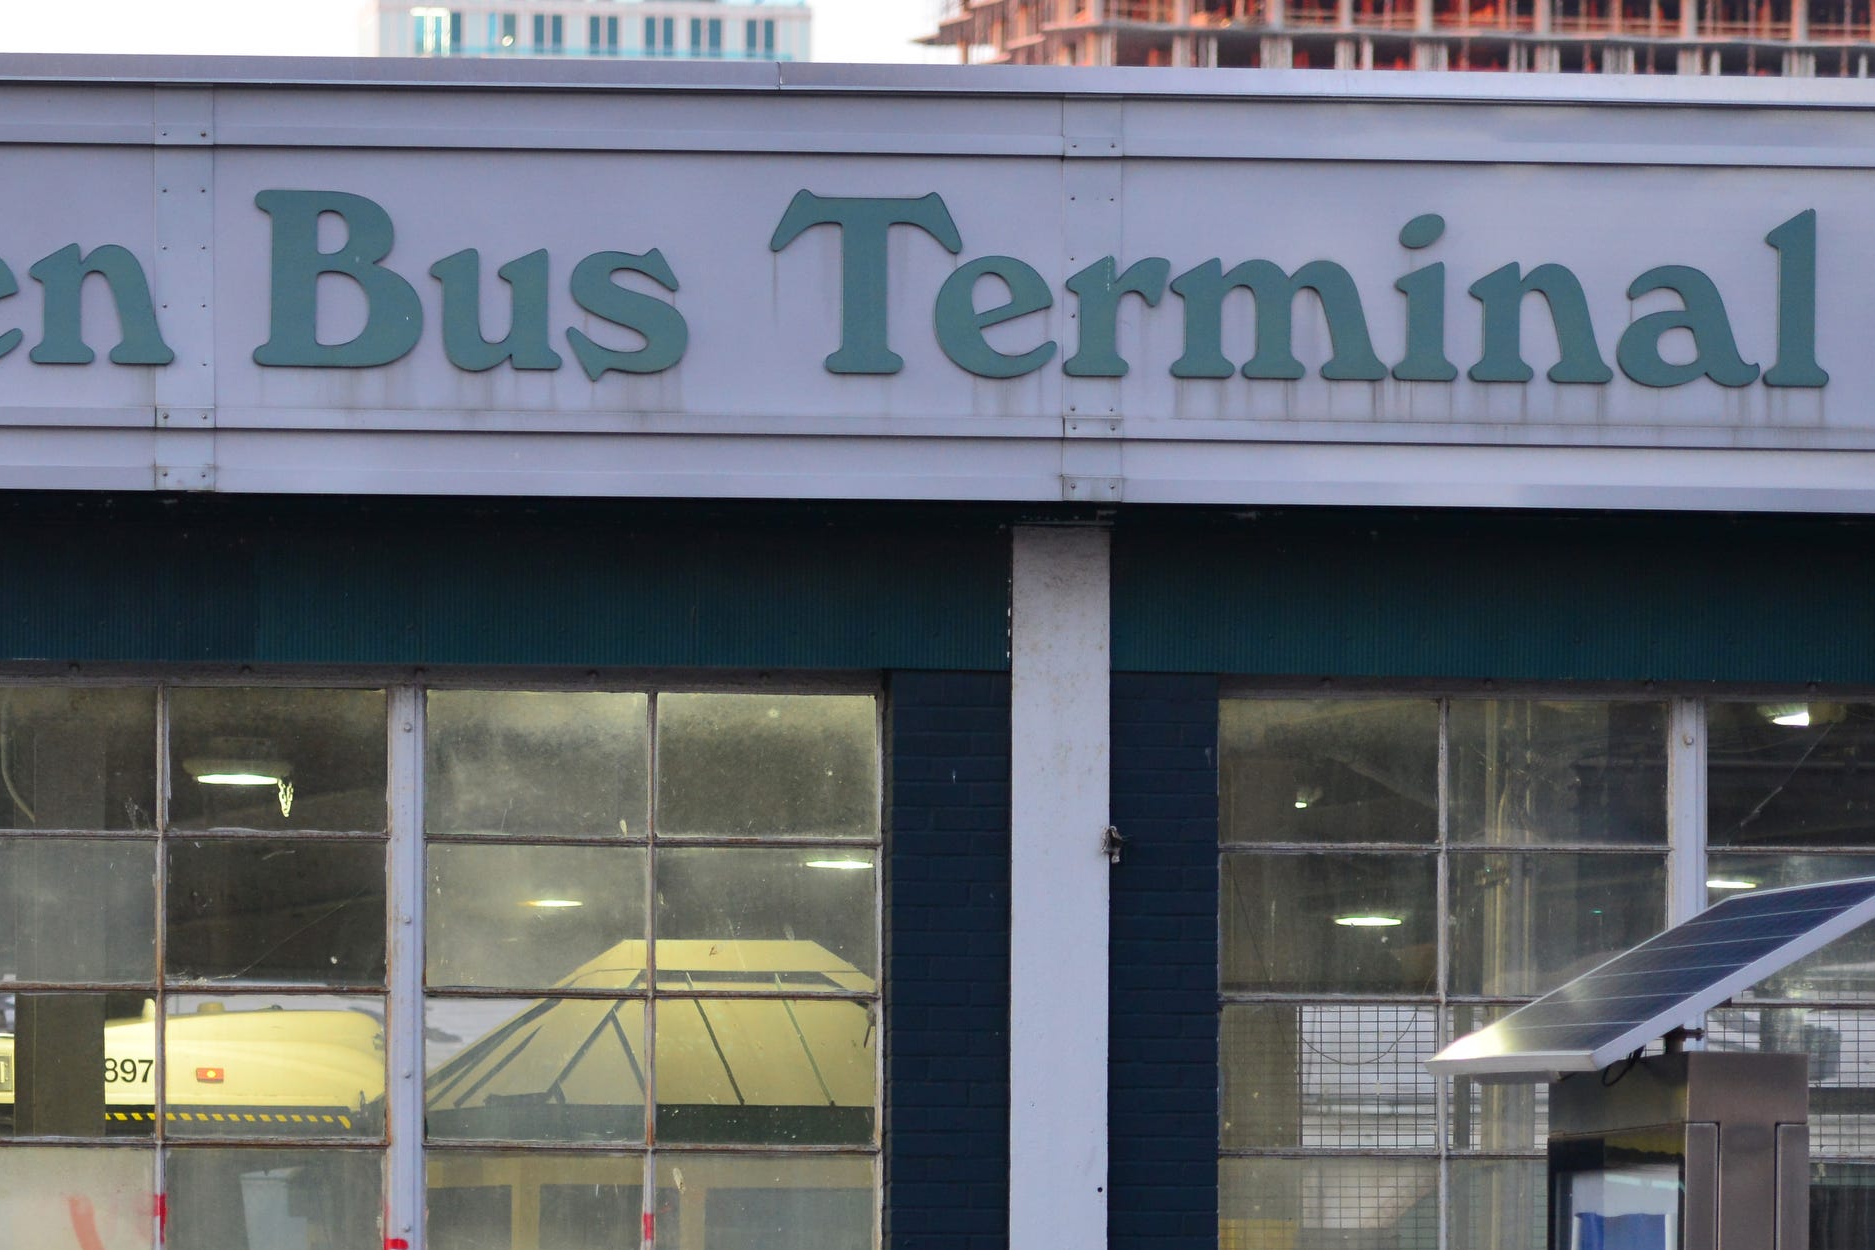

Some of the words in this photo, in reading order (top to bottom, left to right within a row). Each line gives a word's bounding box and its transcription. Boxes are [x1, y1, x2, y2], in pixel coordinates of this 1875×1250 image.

[252, 188, 689, 382] Bus
[768, 187, 1830, 390] Terminal
[104, 1058, 153, 1083] 897
